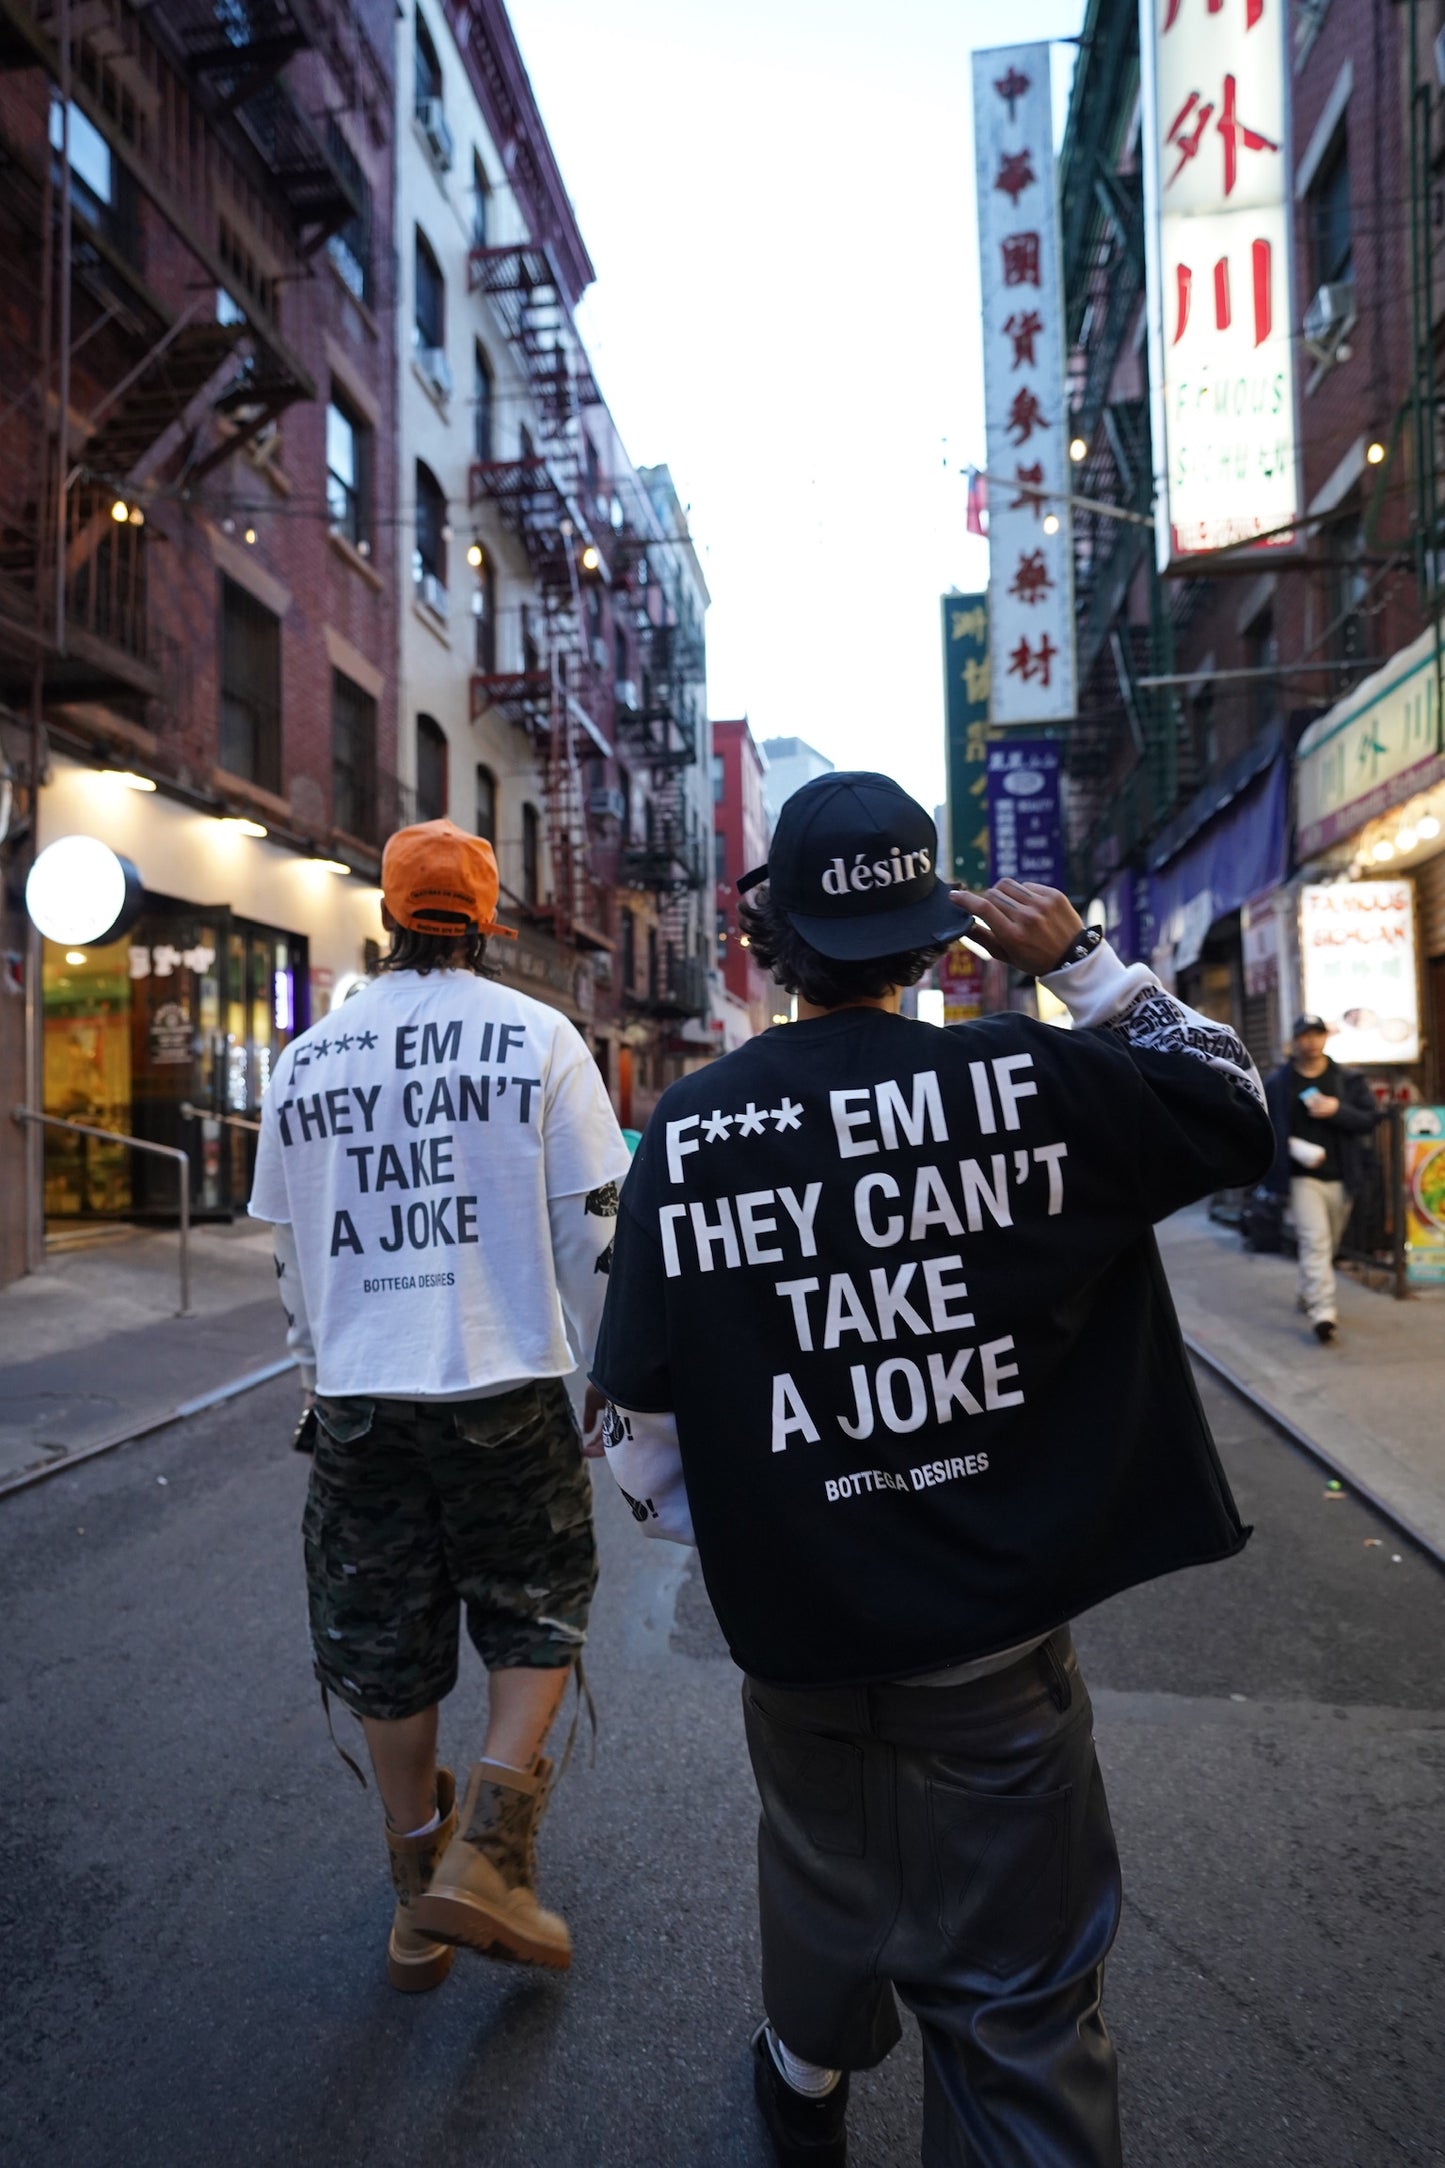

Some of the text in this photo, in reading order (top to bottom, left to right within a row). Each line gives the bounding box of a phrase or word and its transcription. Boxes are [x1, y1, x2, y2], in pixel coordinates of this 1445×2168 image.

[821, 847, 931, 896] désirs
[395, 1020, 463, 1070] EM
[479, 1022, 527, 1064] IF
[277, 1074, 542, 1147] THEY CAN'T
[829, 1069, 950, 1160] EM
[968, 1052, 1039, 1136] IF
[346, 1135, 456, 1194] TAKE
[329, 1195, 480, 1258] A JOKE
[658, 1141, 1069, 1278] THEY CAN'T
[363, 1275, 417, 1294] BOTTEGA
[774, 1254, 976, 1352] TAKE
[770, 1334, 1025, 1453] A JOKE
[824, 1451, 990, 1502] BOTTEGA DESIRES
